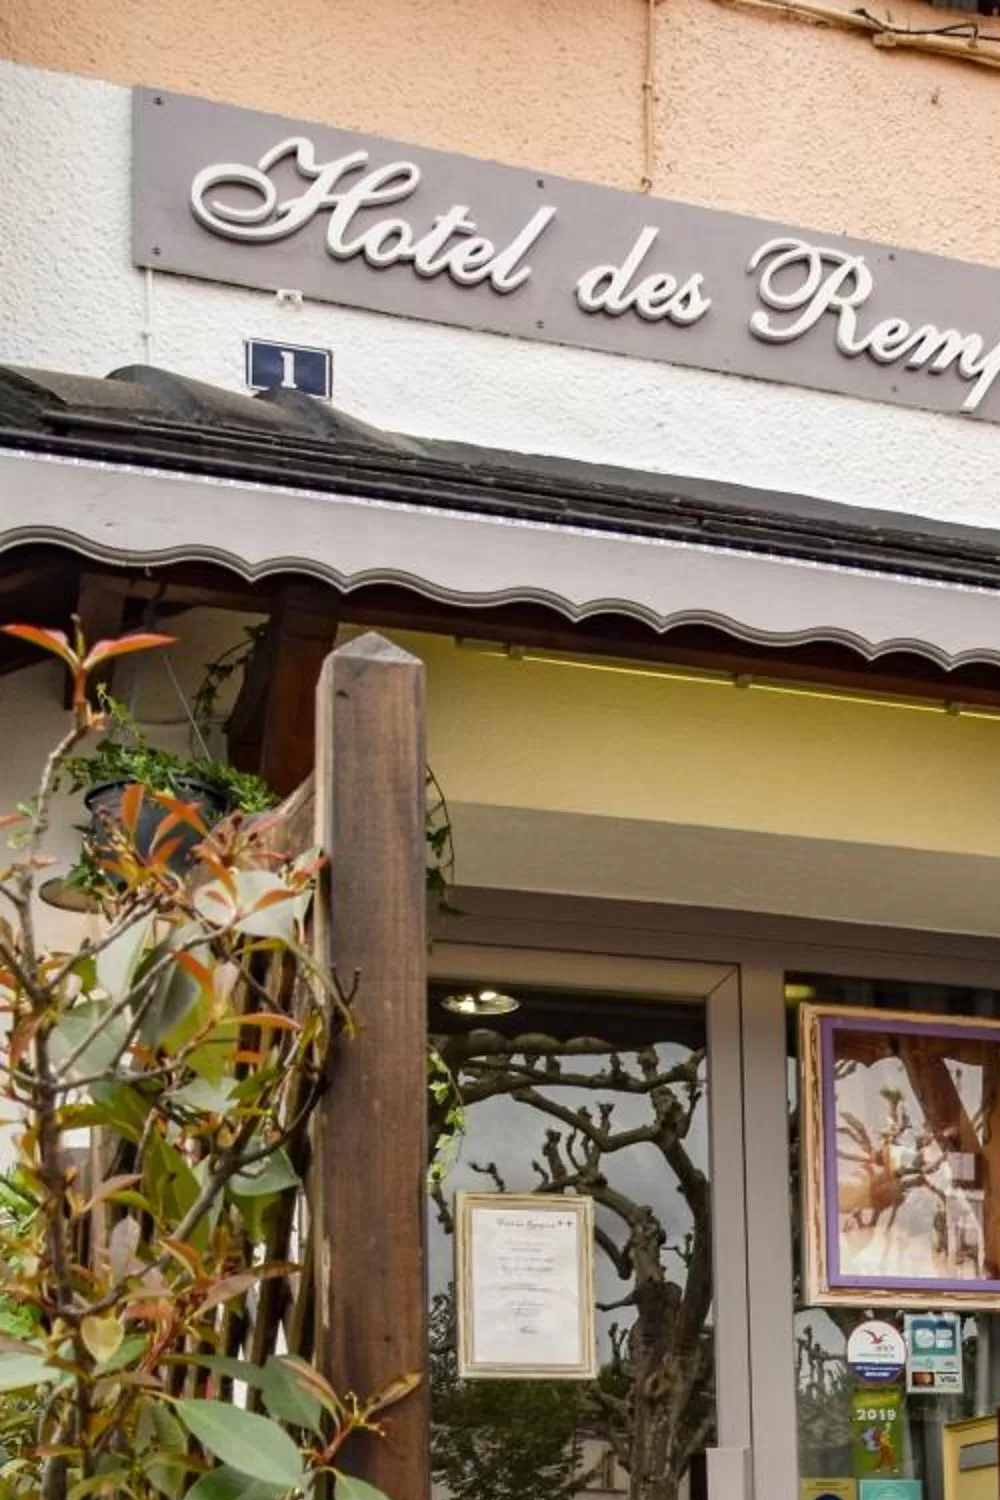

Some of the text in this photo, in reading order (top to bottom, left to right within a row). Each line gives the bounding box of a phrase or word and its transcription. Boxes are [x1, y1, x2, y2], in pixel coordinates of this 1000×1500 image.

[190, 136, 555, 291] Hotel
[575, 226, 712, 324] des
[280, 351, 297, 389] 1
